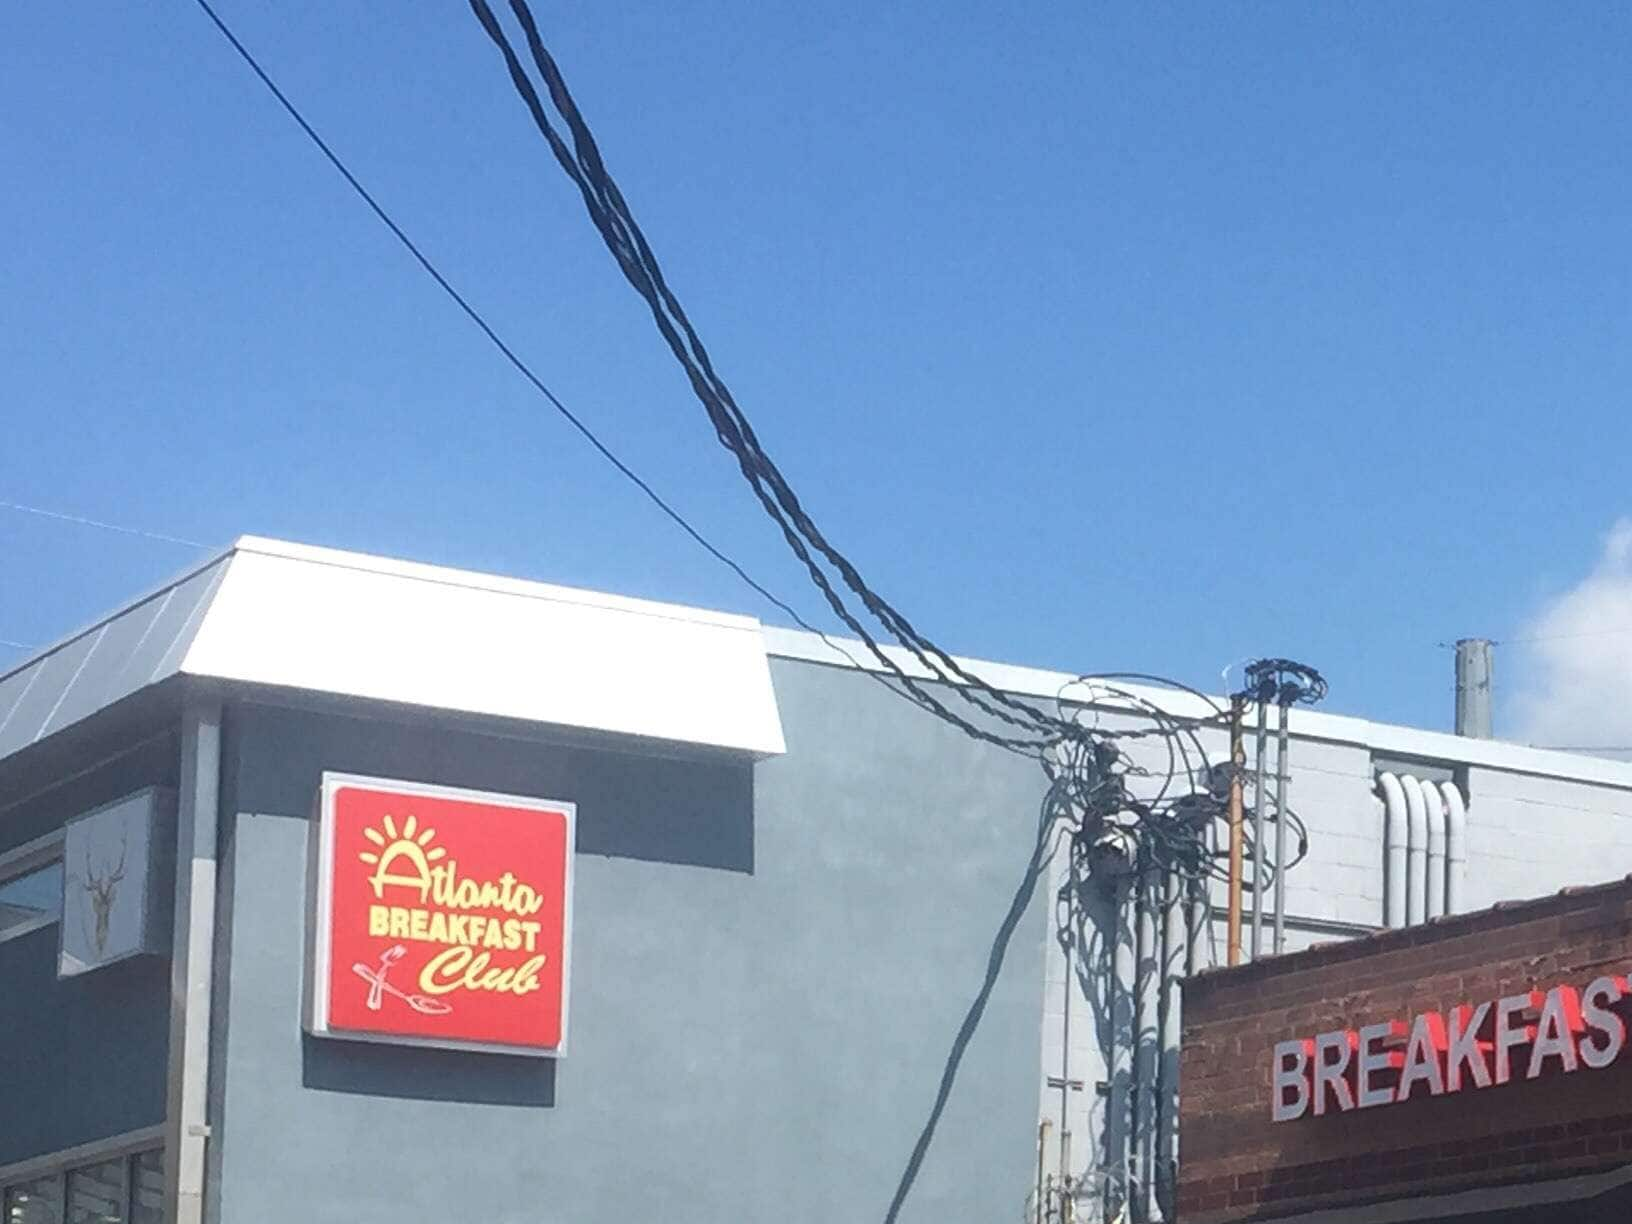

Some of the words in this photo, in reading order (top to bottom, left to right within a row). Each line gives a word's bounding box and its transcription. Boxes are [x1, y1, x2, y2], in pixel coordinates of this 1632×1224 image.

[368, 838, 543, 916] Atlanta
[368, 904, 542, 952] BREAKFAST
[418, 945, 546, 995] Club
